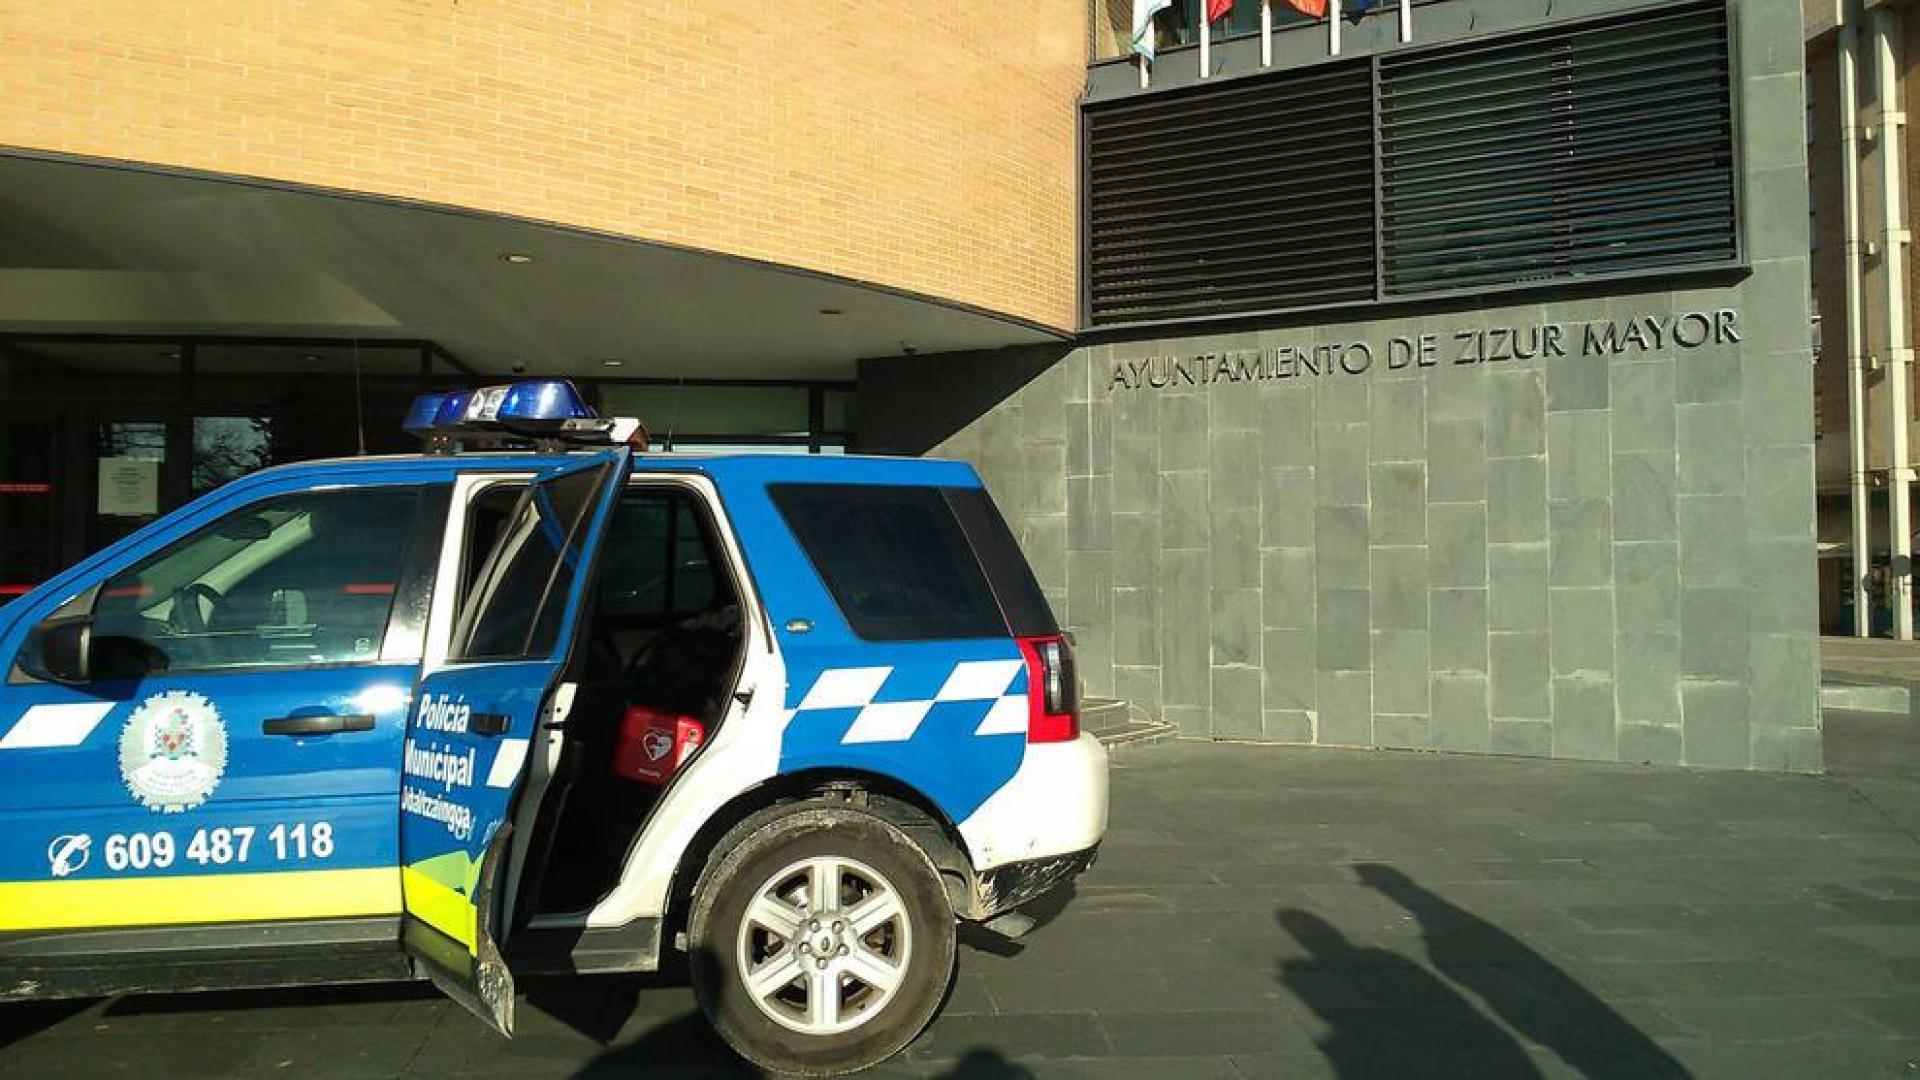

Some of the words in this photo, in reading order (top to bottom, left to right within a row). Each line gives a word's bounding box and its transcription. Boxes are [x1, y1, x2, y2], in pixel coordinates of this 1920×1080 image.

[1109, 342, 1373, 391] AYUNTAMIENTO
[1387, 334, 1437, 370] DE
[1453, 325, 1566, 365] ZIZUR
[1582, 311, 1741, 357] MAYOR
[417, 693, 470, 733] Policía
[404, 738, 475, 792] Municipal
[105, 833, 175, 871] 609
[186, 827, 255, 865] 487
[268, 821, 334, 859] 118
